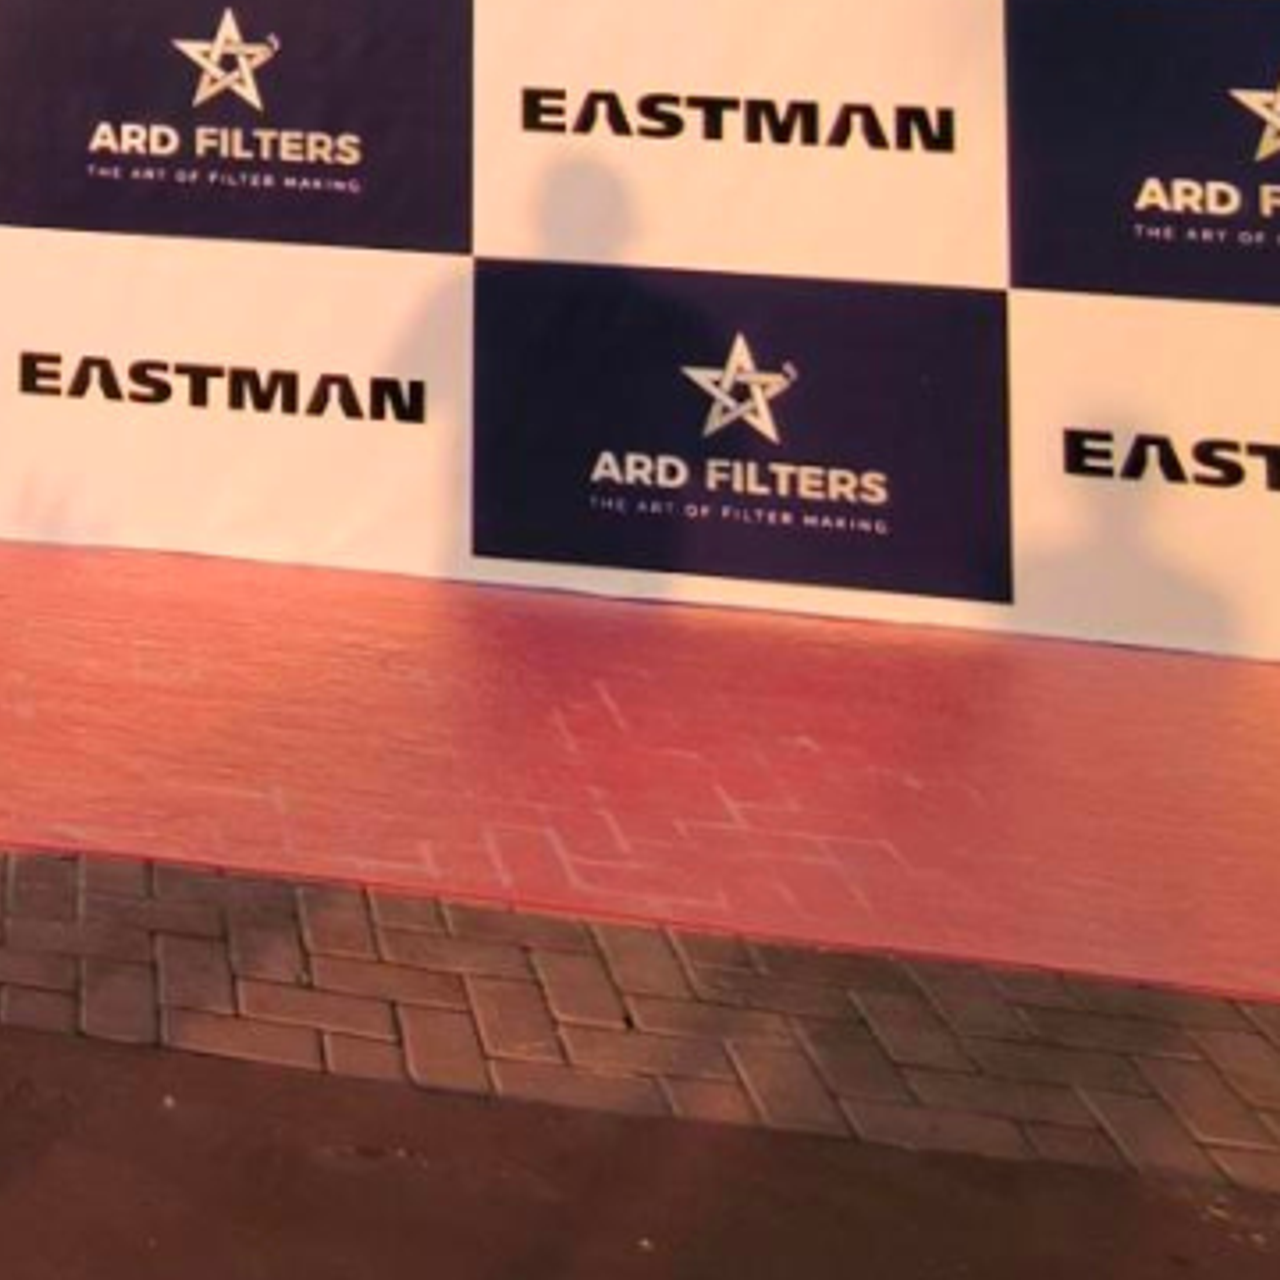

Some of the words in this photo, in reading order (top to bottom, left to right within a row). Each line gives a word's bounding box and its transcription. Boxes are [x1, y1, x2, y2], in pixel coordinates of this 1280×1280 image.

[88, 124, 180, 156] ARD
[195, 127, 362, 165] FILTERS
[522, 88, 954, 153] EASTMAN
[1134, 177, 1241, 215] ARD
[20, 352, 426, 424] EASTMAN
[590, 451, 689, 488] ARD
[706, 459, 888, 505] FILTERS
